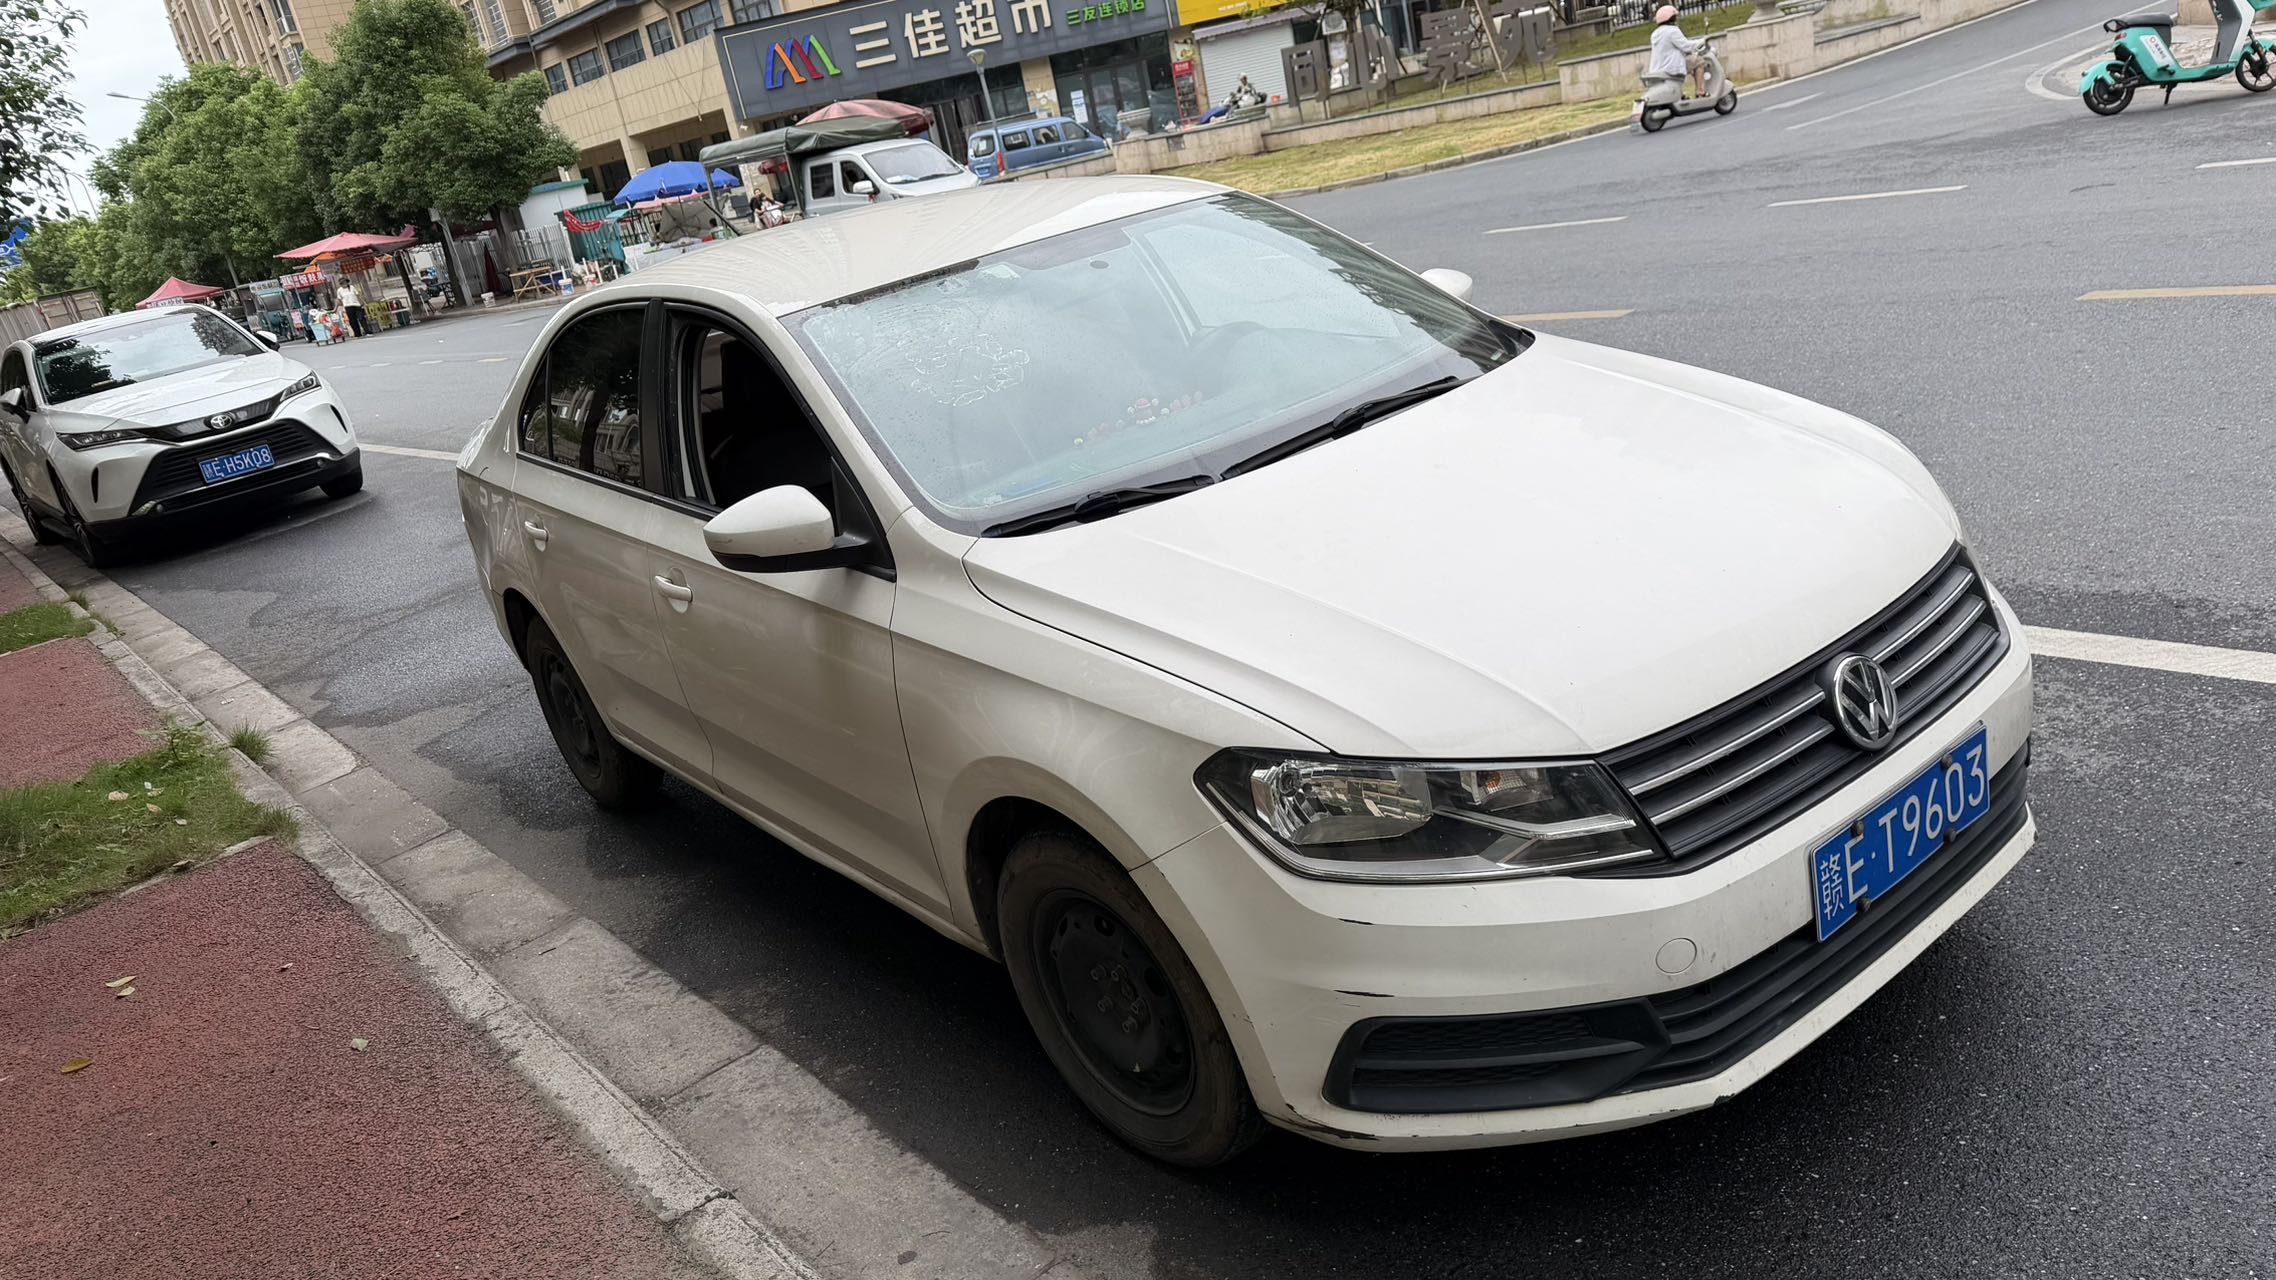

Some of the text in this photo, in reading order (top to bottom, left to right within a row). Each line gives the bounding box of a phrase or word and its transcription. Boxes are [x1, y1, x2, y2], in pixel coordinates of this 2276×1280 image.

[849, 0, 1052, 69] 三佳超市
[1065, 0, 1146, 25] 三友连锁店
[1819, 743, 1986, 921] 赣E·T9603
